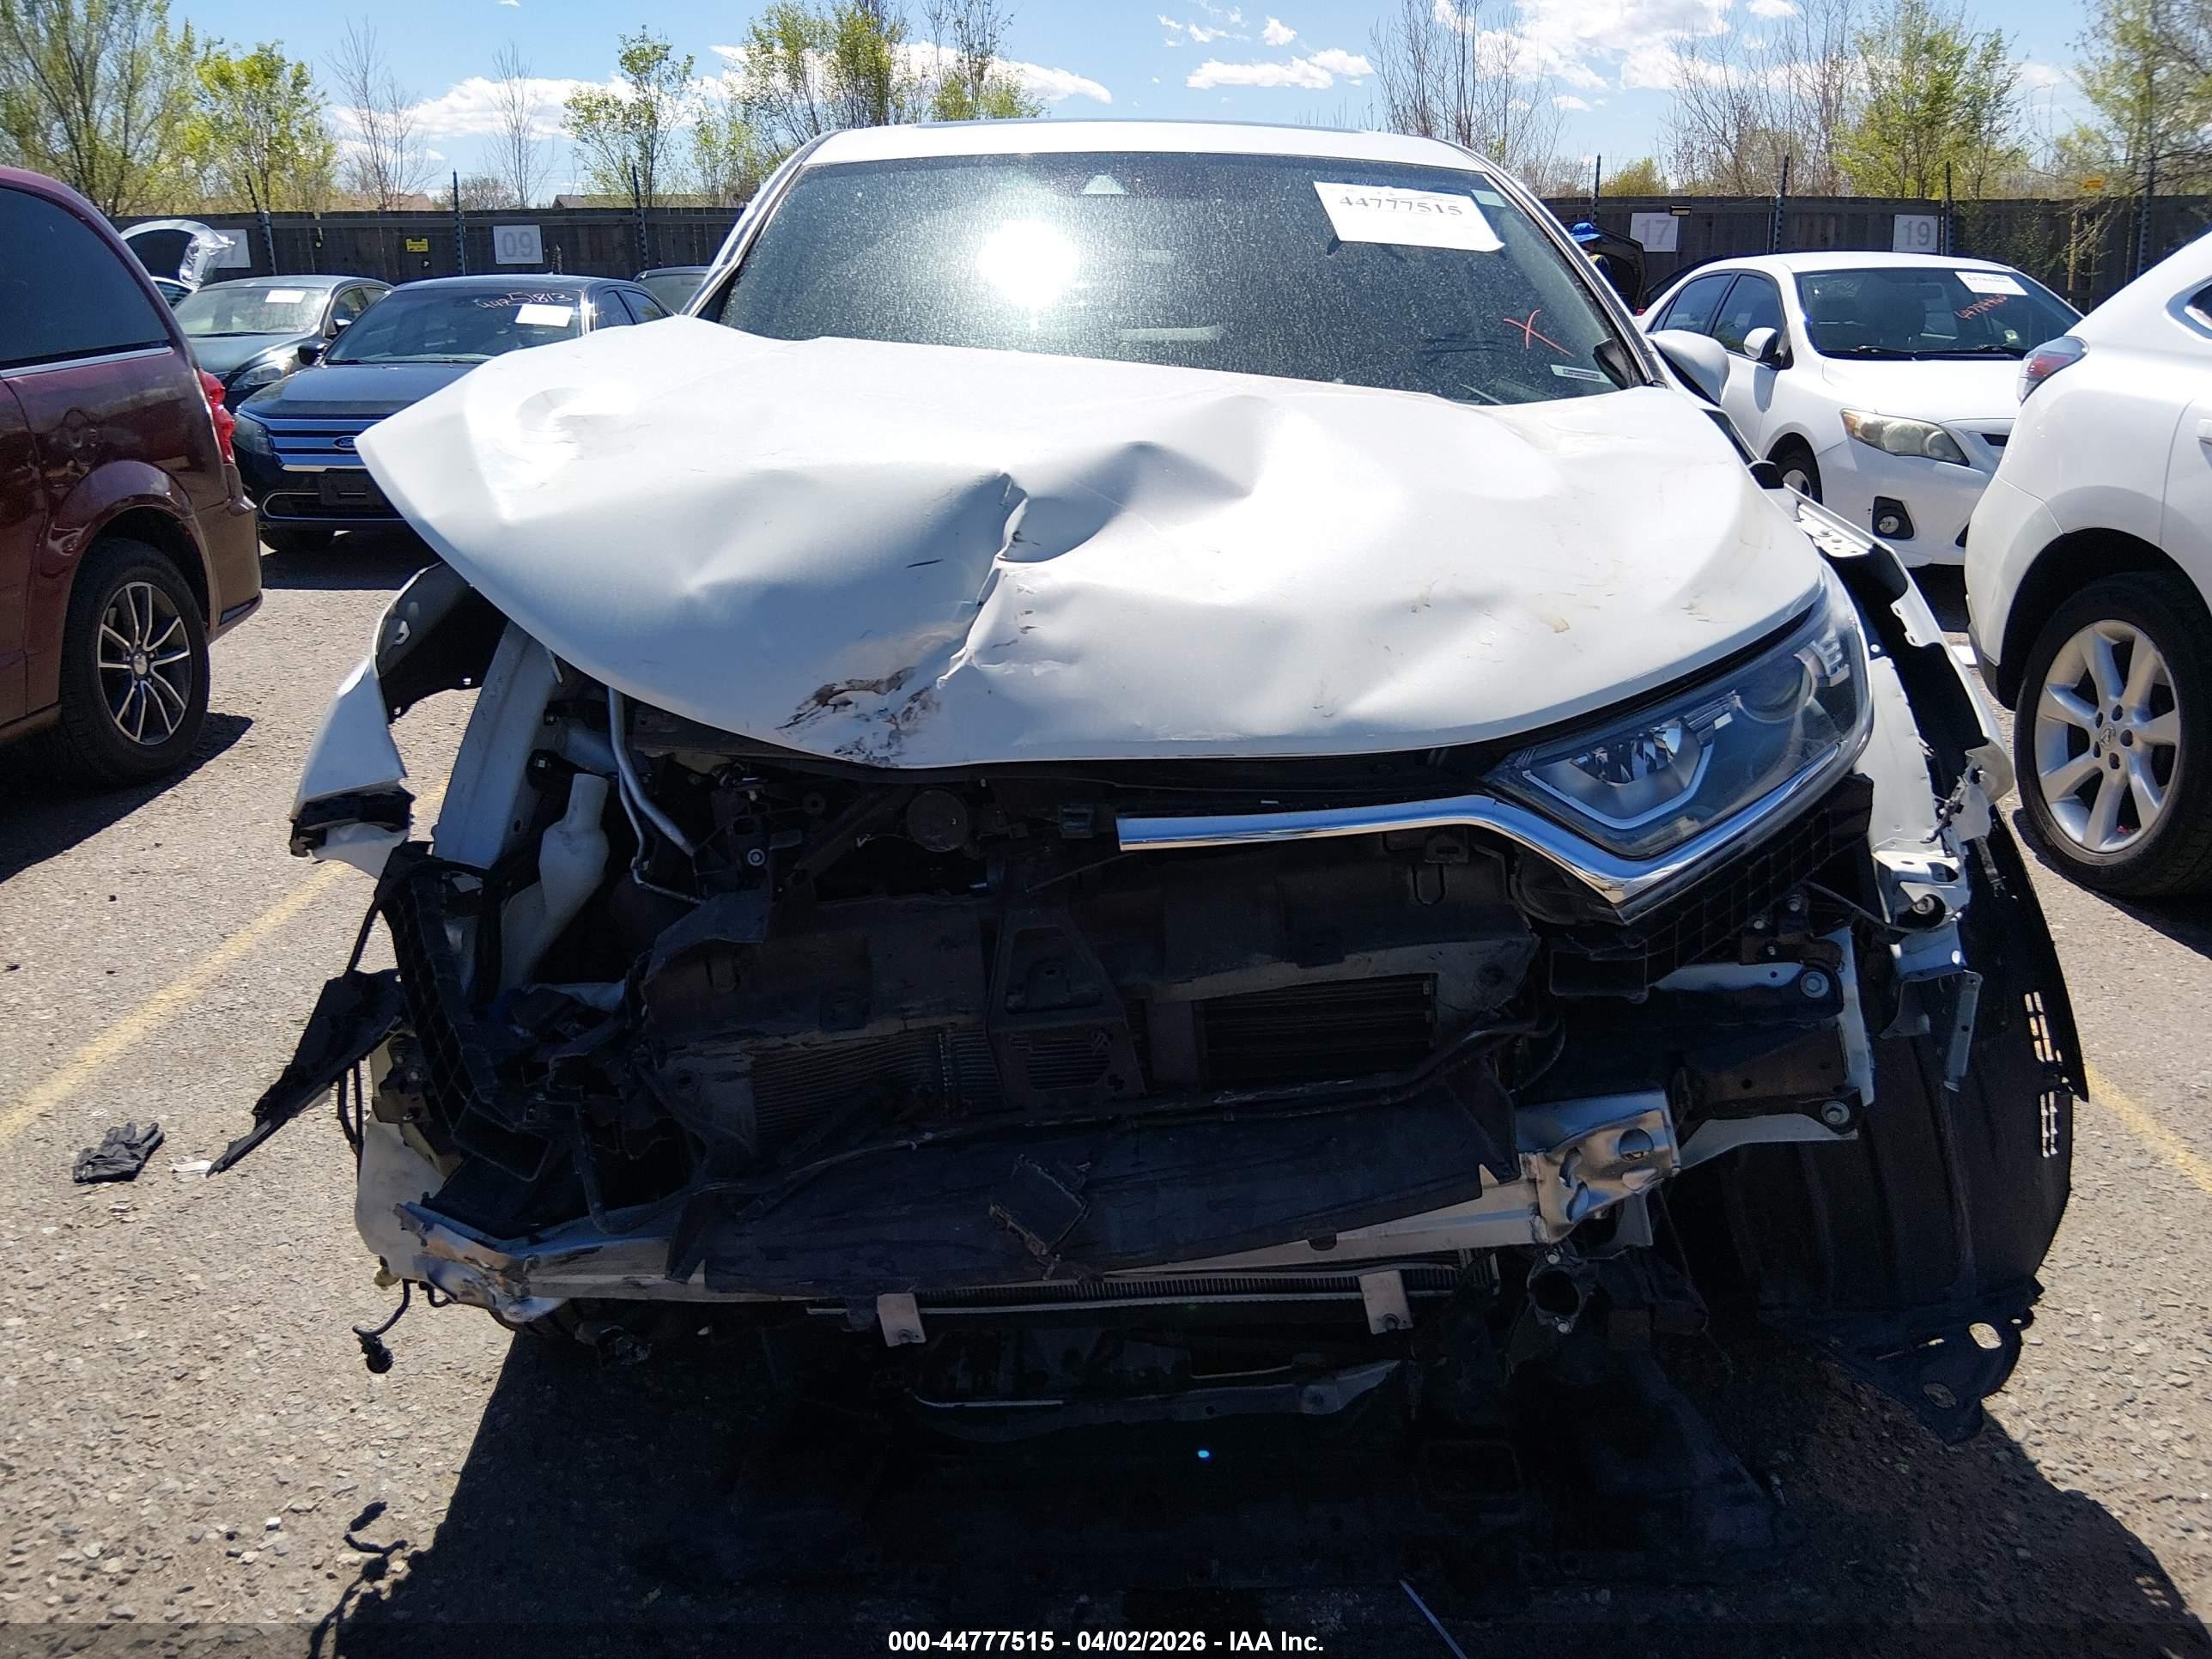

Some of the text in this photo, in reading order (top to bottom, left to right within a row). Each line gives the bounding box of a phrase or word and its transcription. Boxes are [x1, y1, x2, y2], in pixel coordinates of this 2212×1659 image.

[1339, 195, 1463, 216] 44777515
[501, 231, 533, 258] 09
[1639, 219, 1671, 246] 17
[1903, 220, 1931, 246] 19
